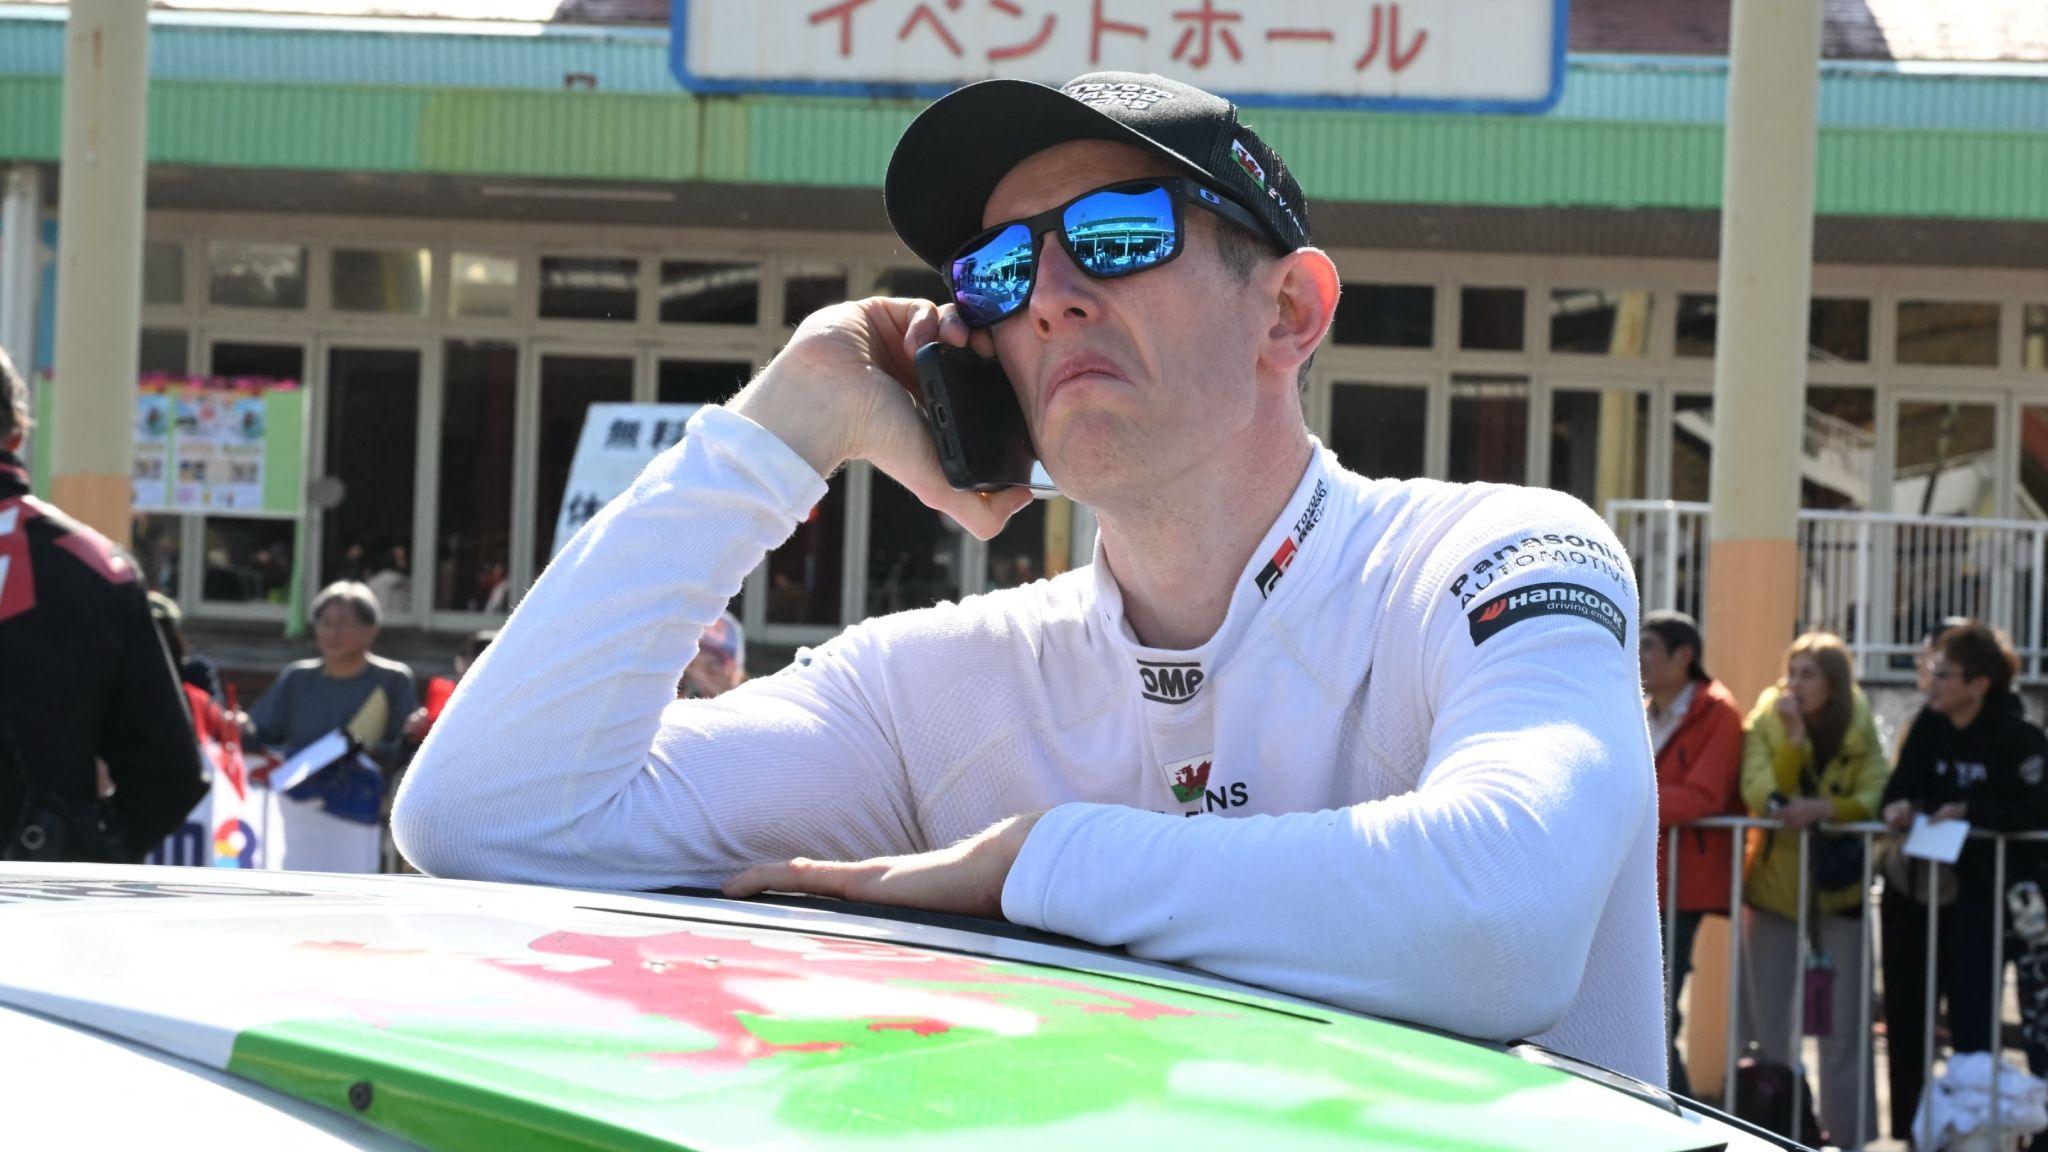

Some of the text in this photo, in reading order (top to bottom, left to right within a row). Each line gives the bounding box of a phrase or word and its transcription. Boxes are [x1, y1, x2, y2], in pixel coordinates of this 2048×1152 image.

[809, 0, 1427, 70] イベントホール
[1068, 83, 1174, 99] TOYOTA
[1450, 534, 1626, 597] Panasonic
[1461, 550, 1630, 610] AUTOMOTIVE
[1546, 602, 1588, 614] driving
[1139, 667, 1204, 697] OMP
